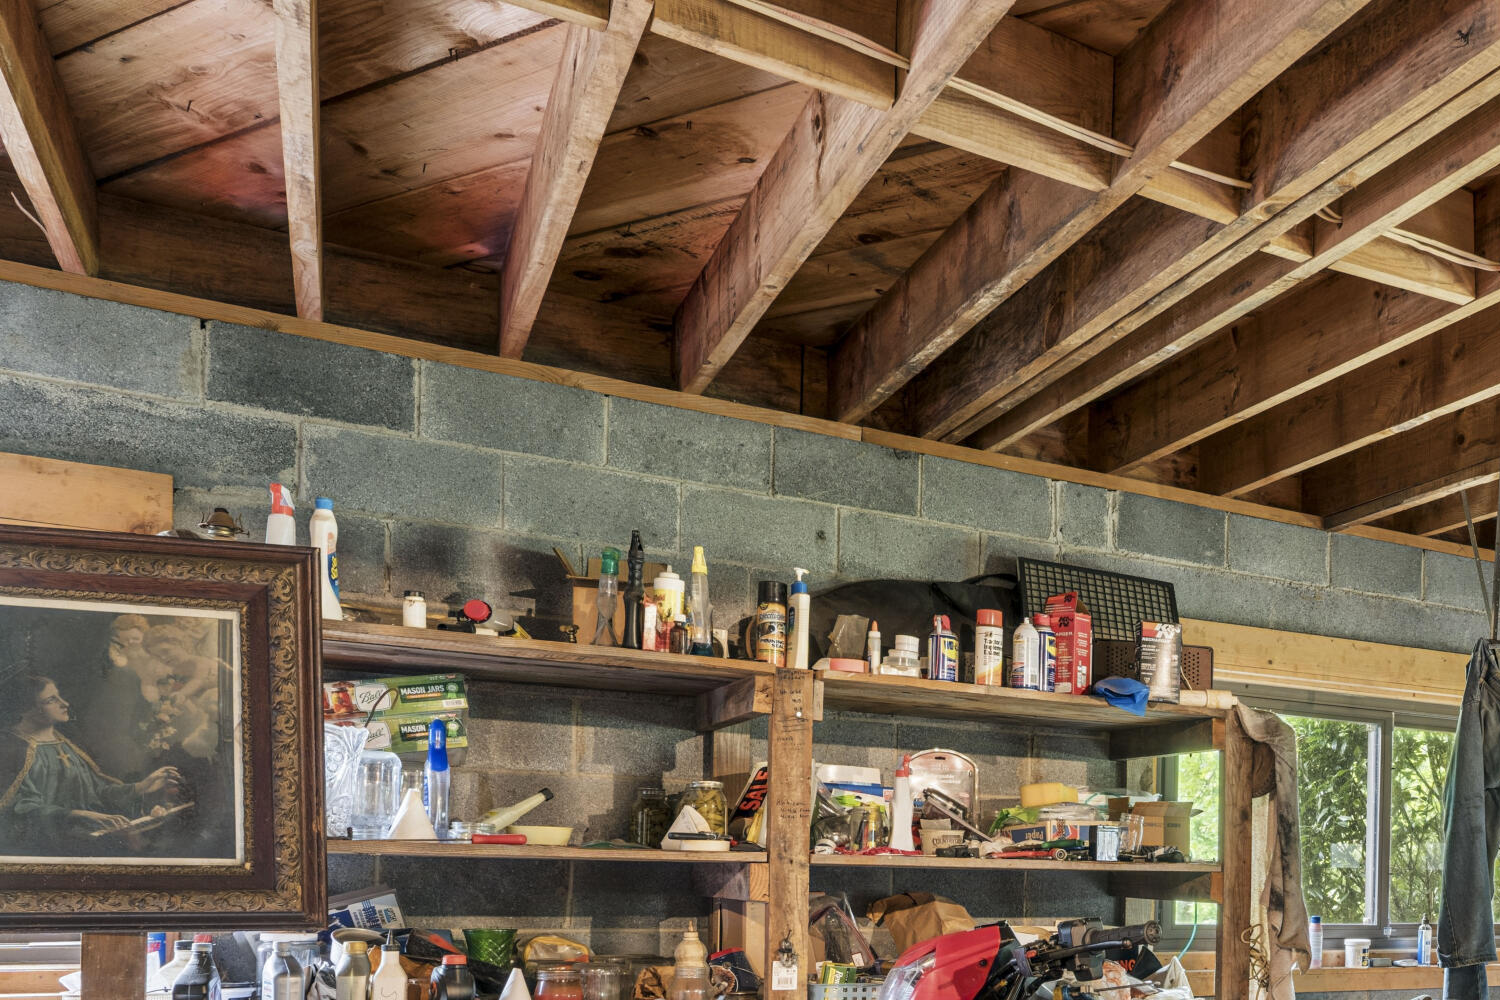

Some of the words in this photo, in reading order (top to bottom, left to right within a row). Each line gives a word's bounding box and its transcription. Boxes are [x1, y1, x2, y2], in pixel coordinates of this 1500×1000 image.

[359, 689, 385, 704] Ball
[400, 685, 426, 696] MASON
[427, 684, 445, 693] JARS
[368, 727, 385, 742] all
[400, 723, 426, 734] MASON
